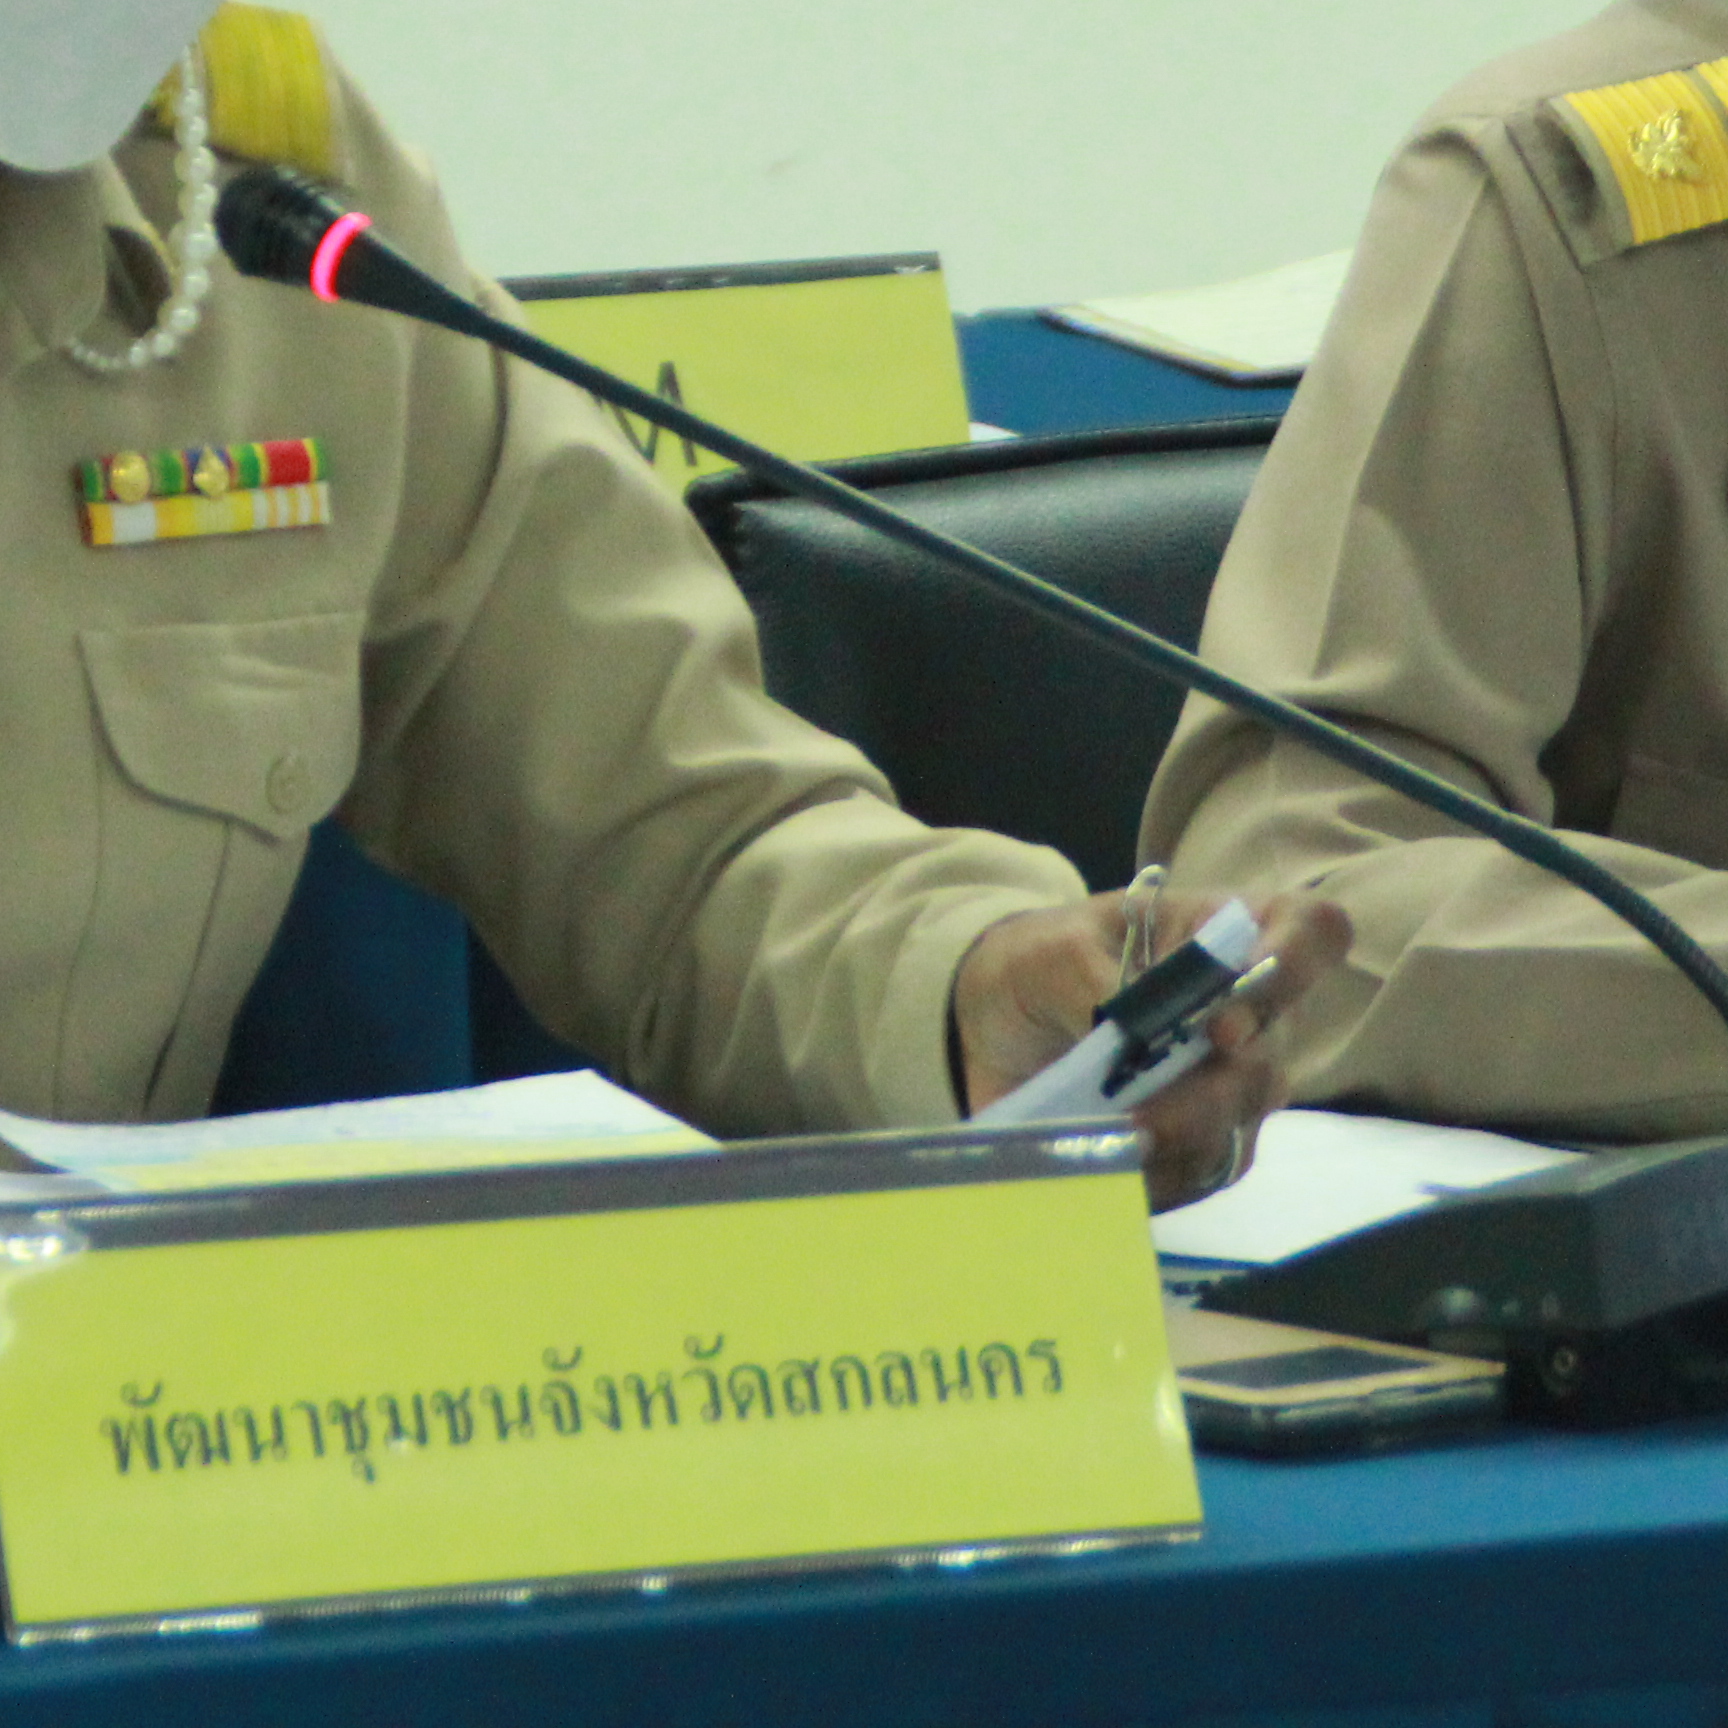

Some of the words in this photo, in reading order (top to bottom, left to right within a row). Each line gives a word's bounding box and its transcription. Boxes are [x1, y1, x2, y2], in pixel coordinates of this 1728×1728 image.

[97, 1332, 1067, 1484] พัฒนาชุมชนจังหวัดสกลนคร
